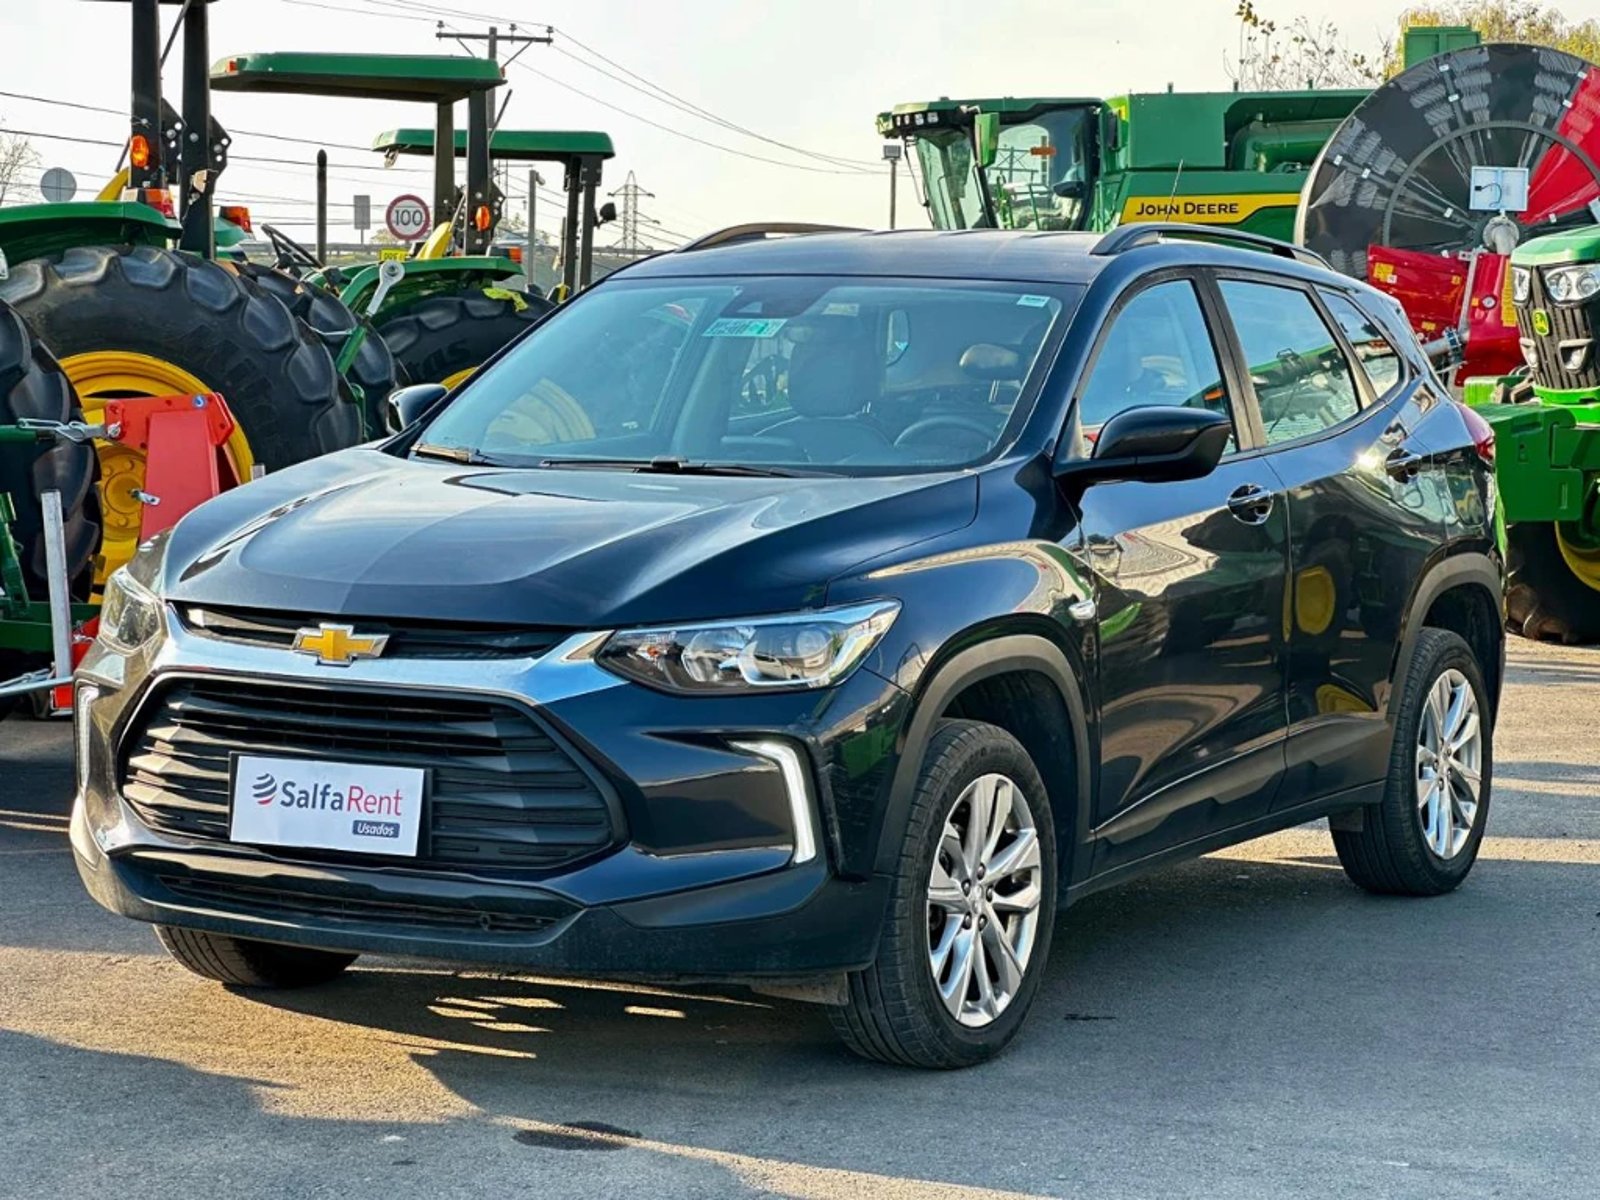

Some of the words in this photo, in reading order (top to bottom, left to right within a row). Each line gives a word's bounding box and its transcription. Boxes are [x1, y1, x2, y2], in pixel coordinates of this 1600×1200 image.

[1136, 202, 1180, 215] JOHN
[1184, 202, 1239, 214] DEERE
[395, 208, 423, 227] 100
[280, 780, 404, 817] SalfaRent
[357, 822, 394, 837] Usados
